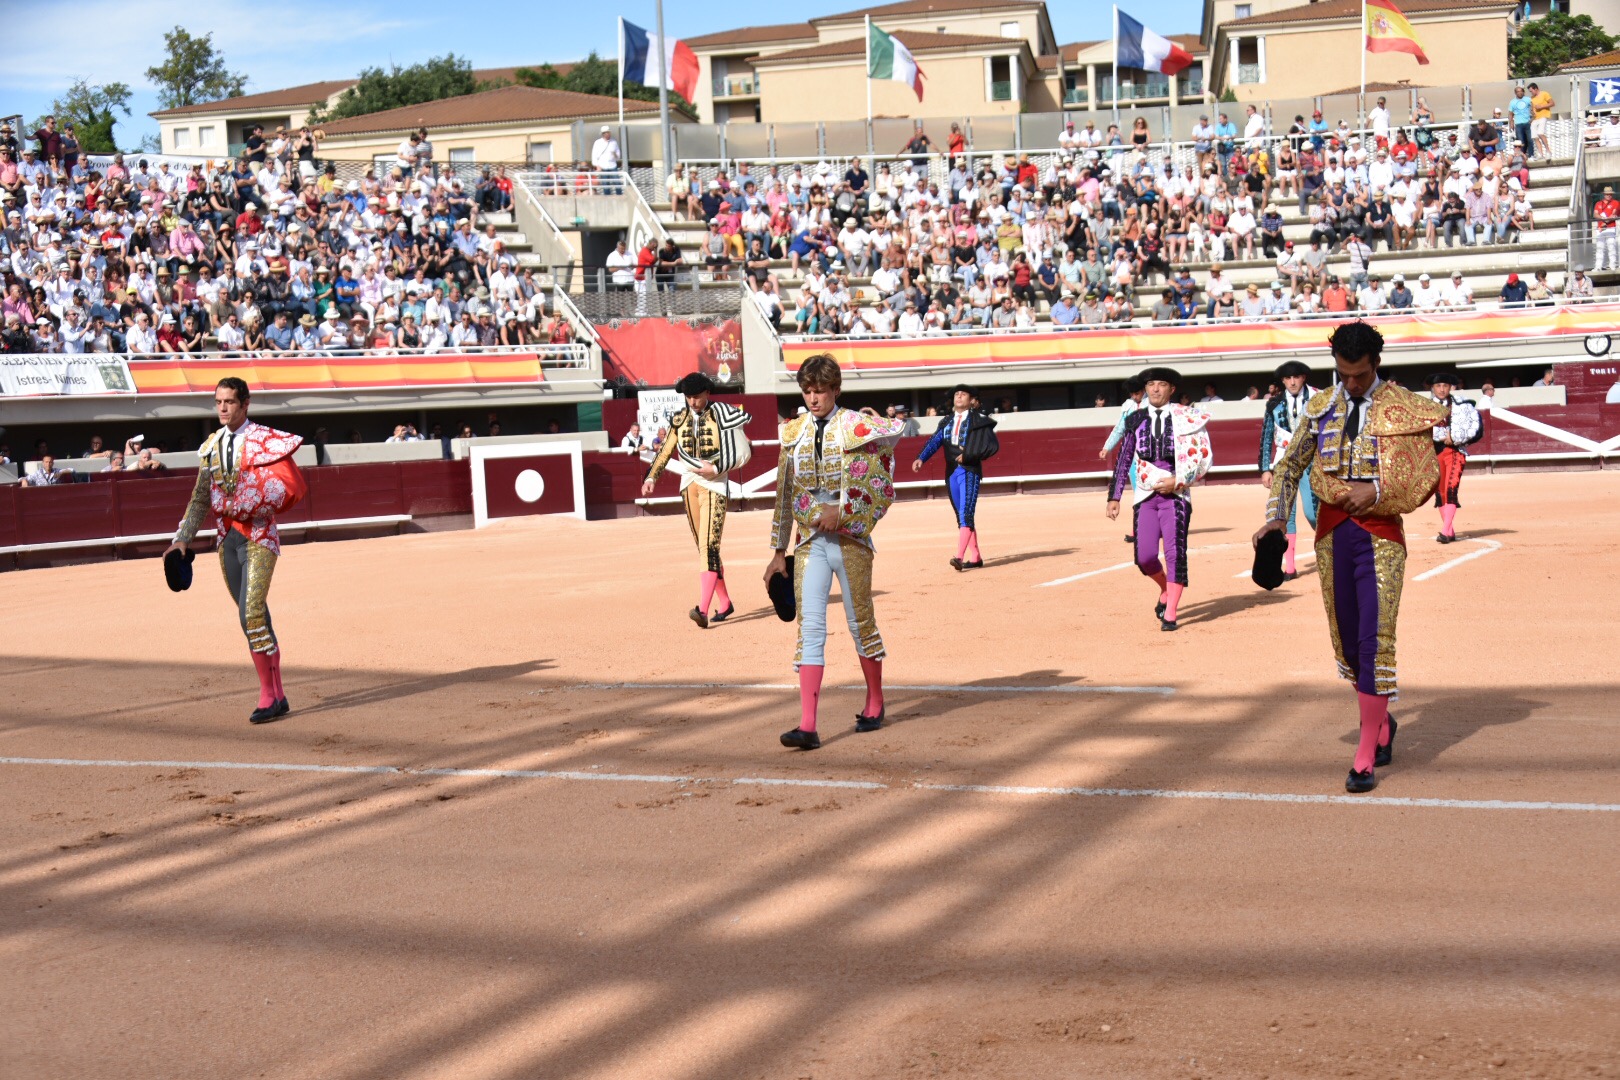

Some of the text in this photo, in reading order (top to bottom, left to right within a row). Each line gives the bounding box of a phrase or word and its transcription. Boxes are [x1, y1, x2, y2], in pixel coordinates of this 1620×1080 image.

[64, 355, 121, 365] CASTELLA
[1590, 367, 1617, 375] TORIL
[16, 374, 52, 386] Istres-
[644, 395, 679, 403] VALVERDE
[652, 411, 659, 423] 6
